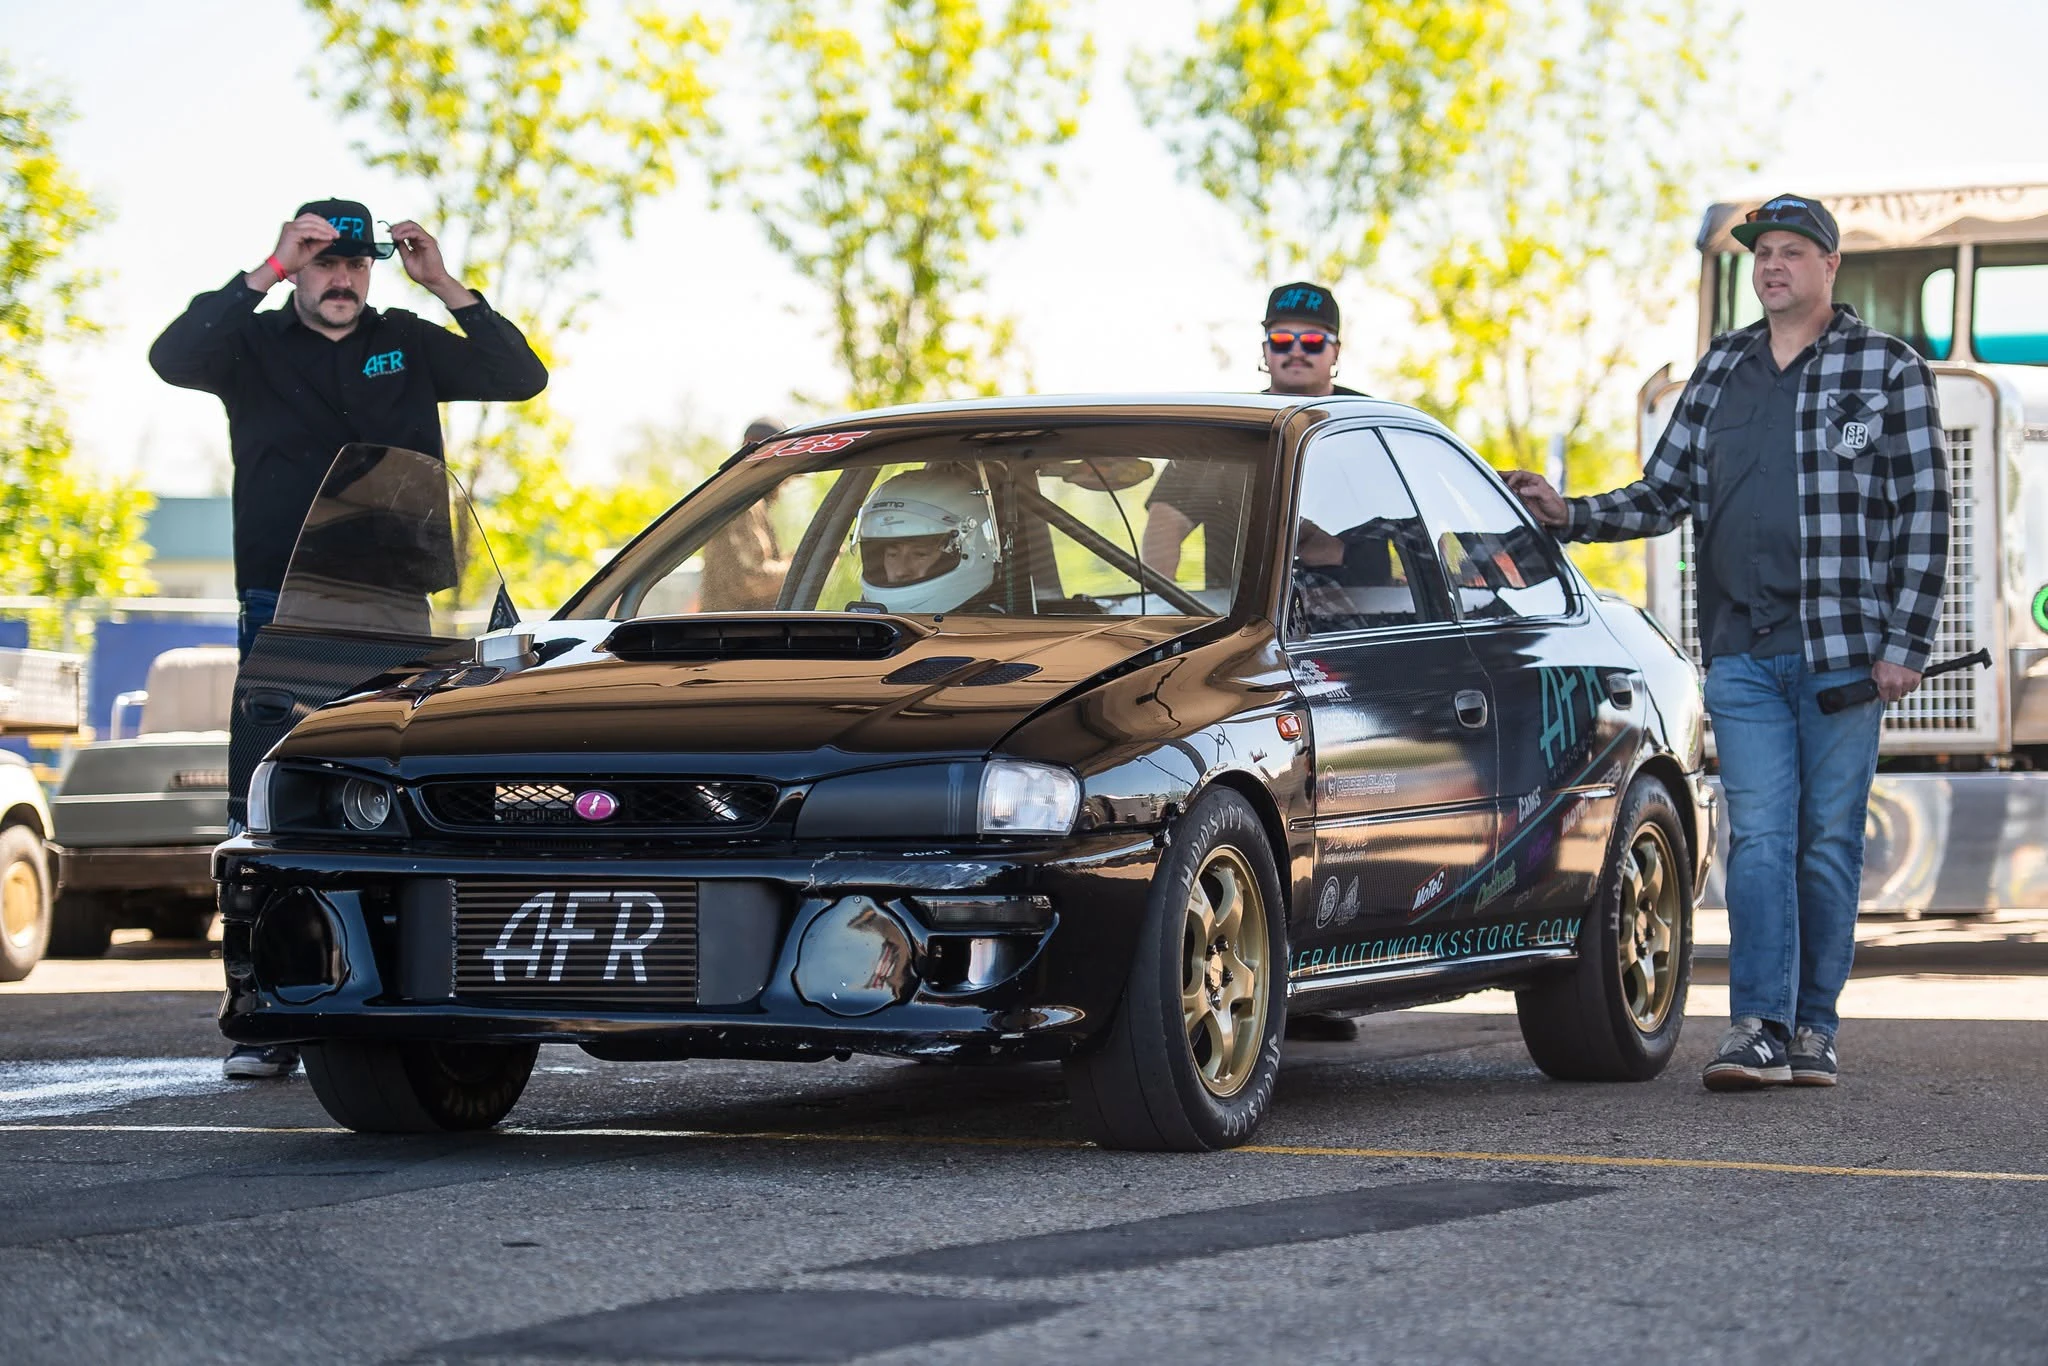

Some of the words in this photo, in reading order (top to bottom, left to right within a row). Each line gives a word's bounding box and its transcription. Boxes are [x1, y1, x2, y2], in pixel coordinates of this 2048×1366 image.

[1275, 287, 1323, 312] AFR
[362, 350, 405, 377] AFR
[744, 430, 872, 463] 135
[1367, 772, 1397, 788] CLARK
[1411, 871, 1445, 912] MoTeC
[482, 891, 665, 982] AFR
